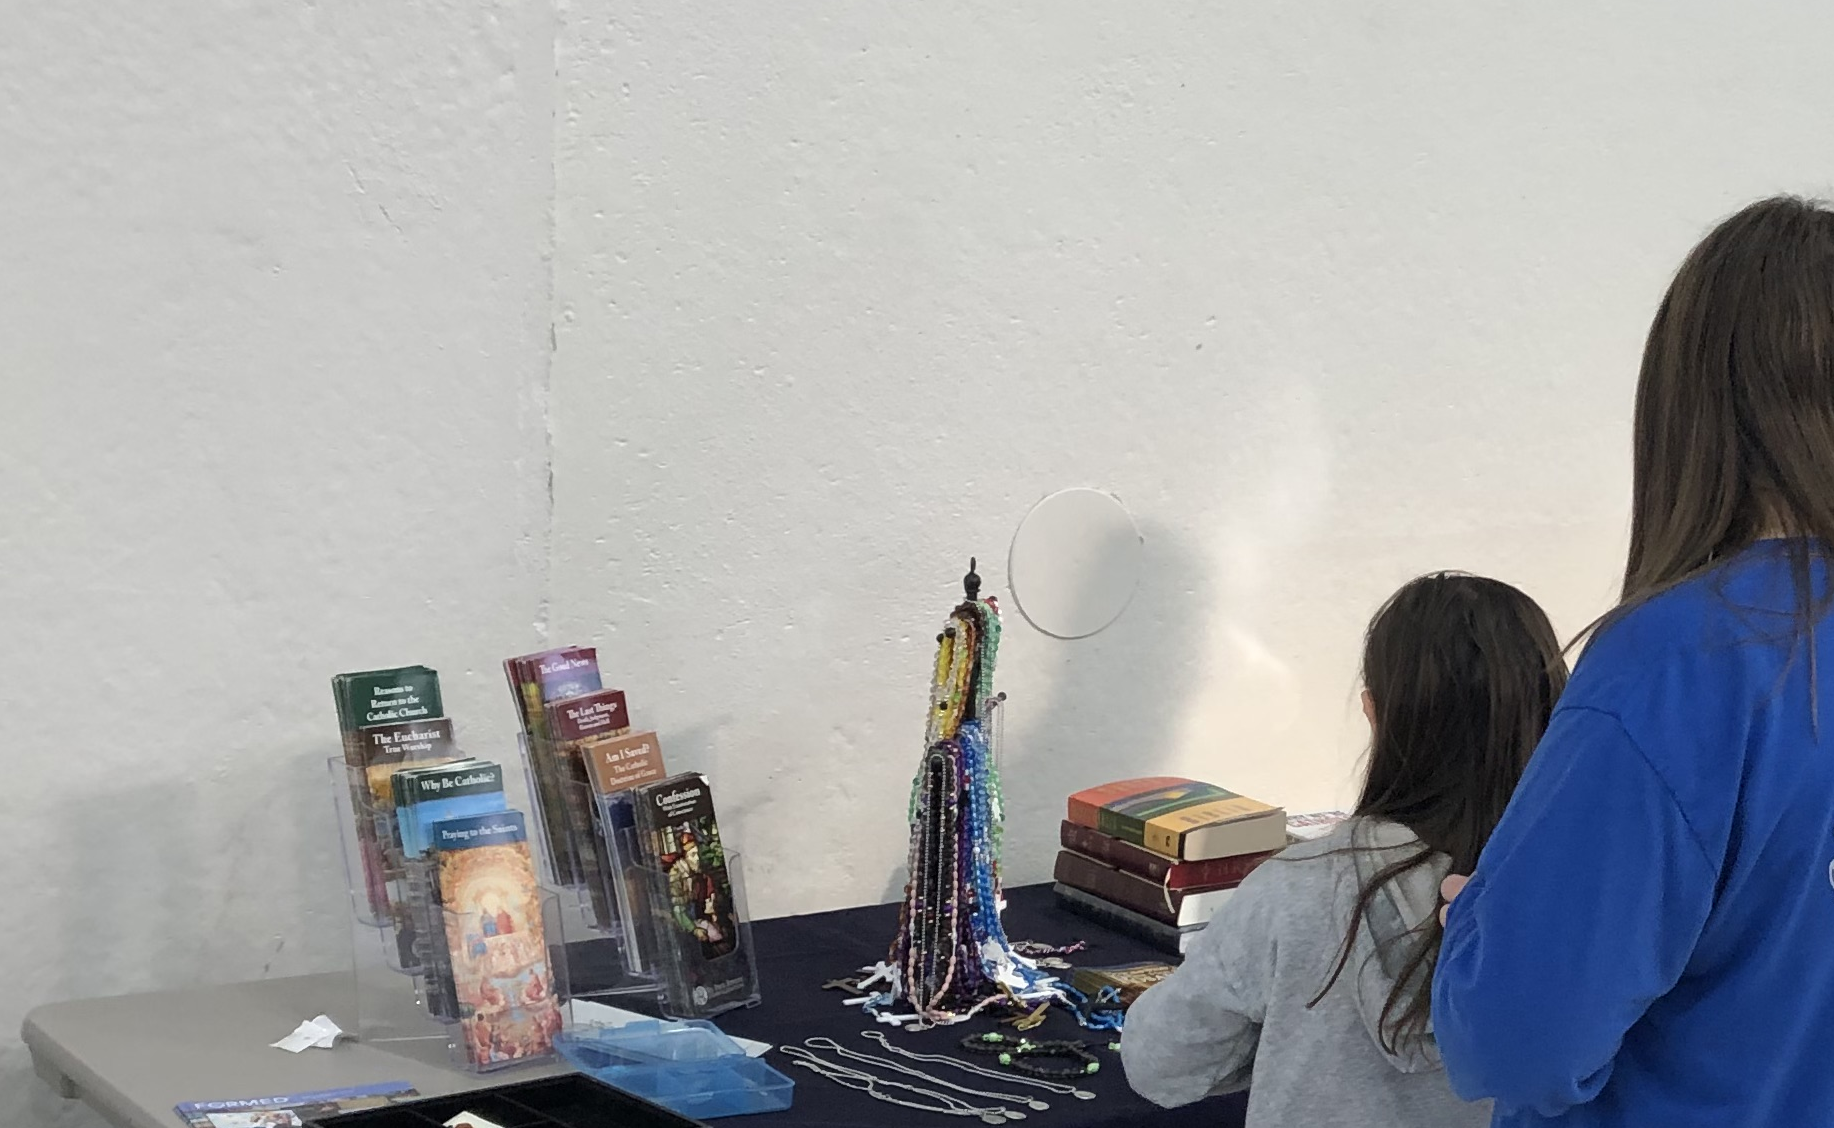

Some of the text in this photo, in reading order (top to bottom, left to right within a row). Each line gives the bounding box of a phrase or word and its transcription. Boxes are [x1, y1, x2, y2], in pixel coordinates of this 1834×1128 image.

[372, 729, 440, 745] The Eucharist
[421, 779, 440, 792] Why
[441, 777, 454, 788] Be
[655, 787, 700, 806] Confession
[194, 1096, 289, 1110] FORMED
